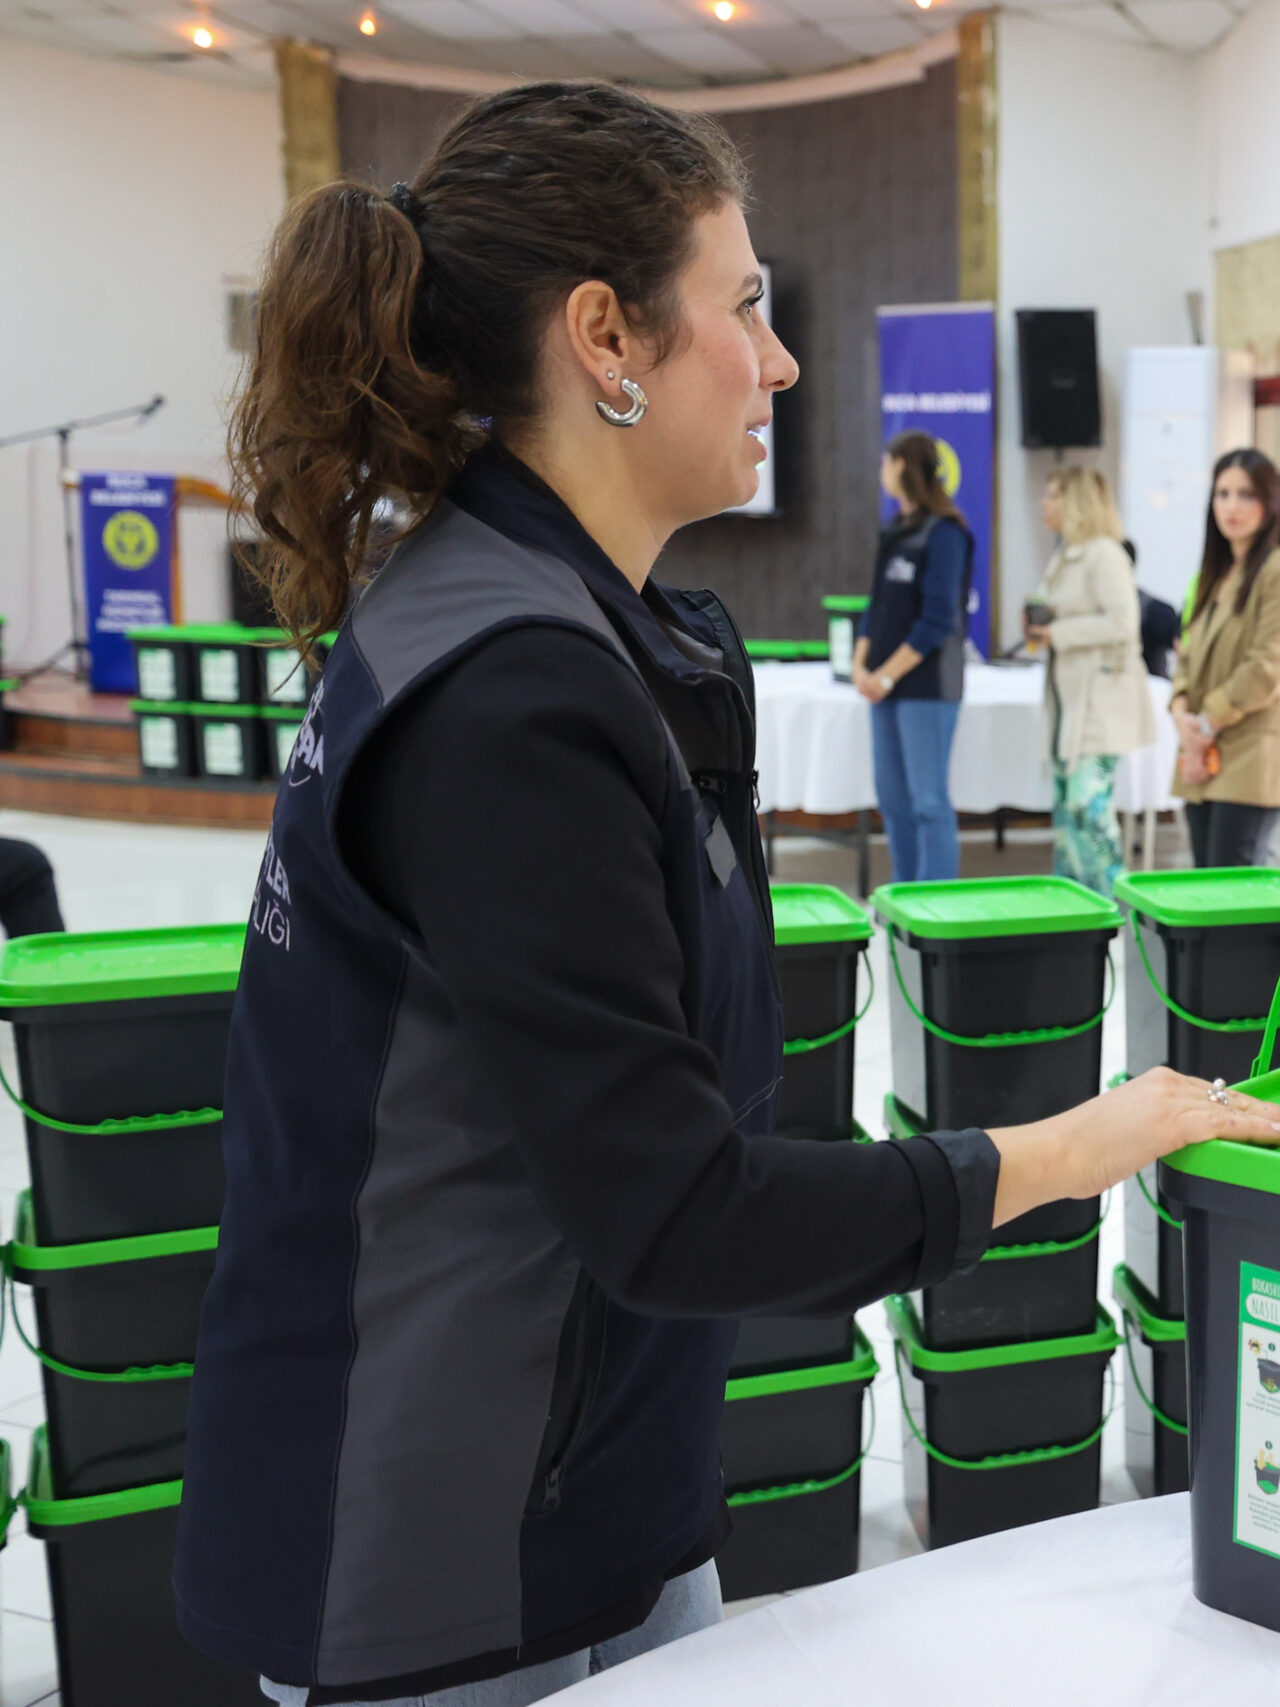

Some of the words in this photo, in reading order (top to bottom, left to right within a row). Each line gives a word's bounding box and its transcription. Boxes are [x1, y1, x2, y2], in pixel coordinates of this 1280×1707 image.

[253, 878, 290, 952] LIĞI
[1252, 1277, 1280, 1299] BOKASHI
[1251, 1298, 1279, 1322] NASIL
